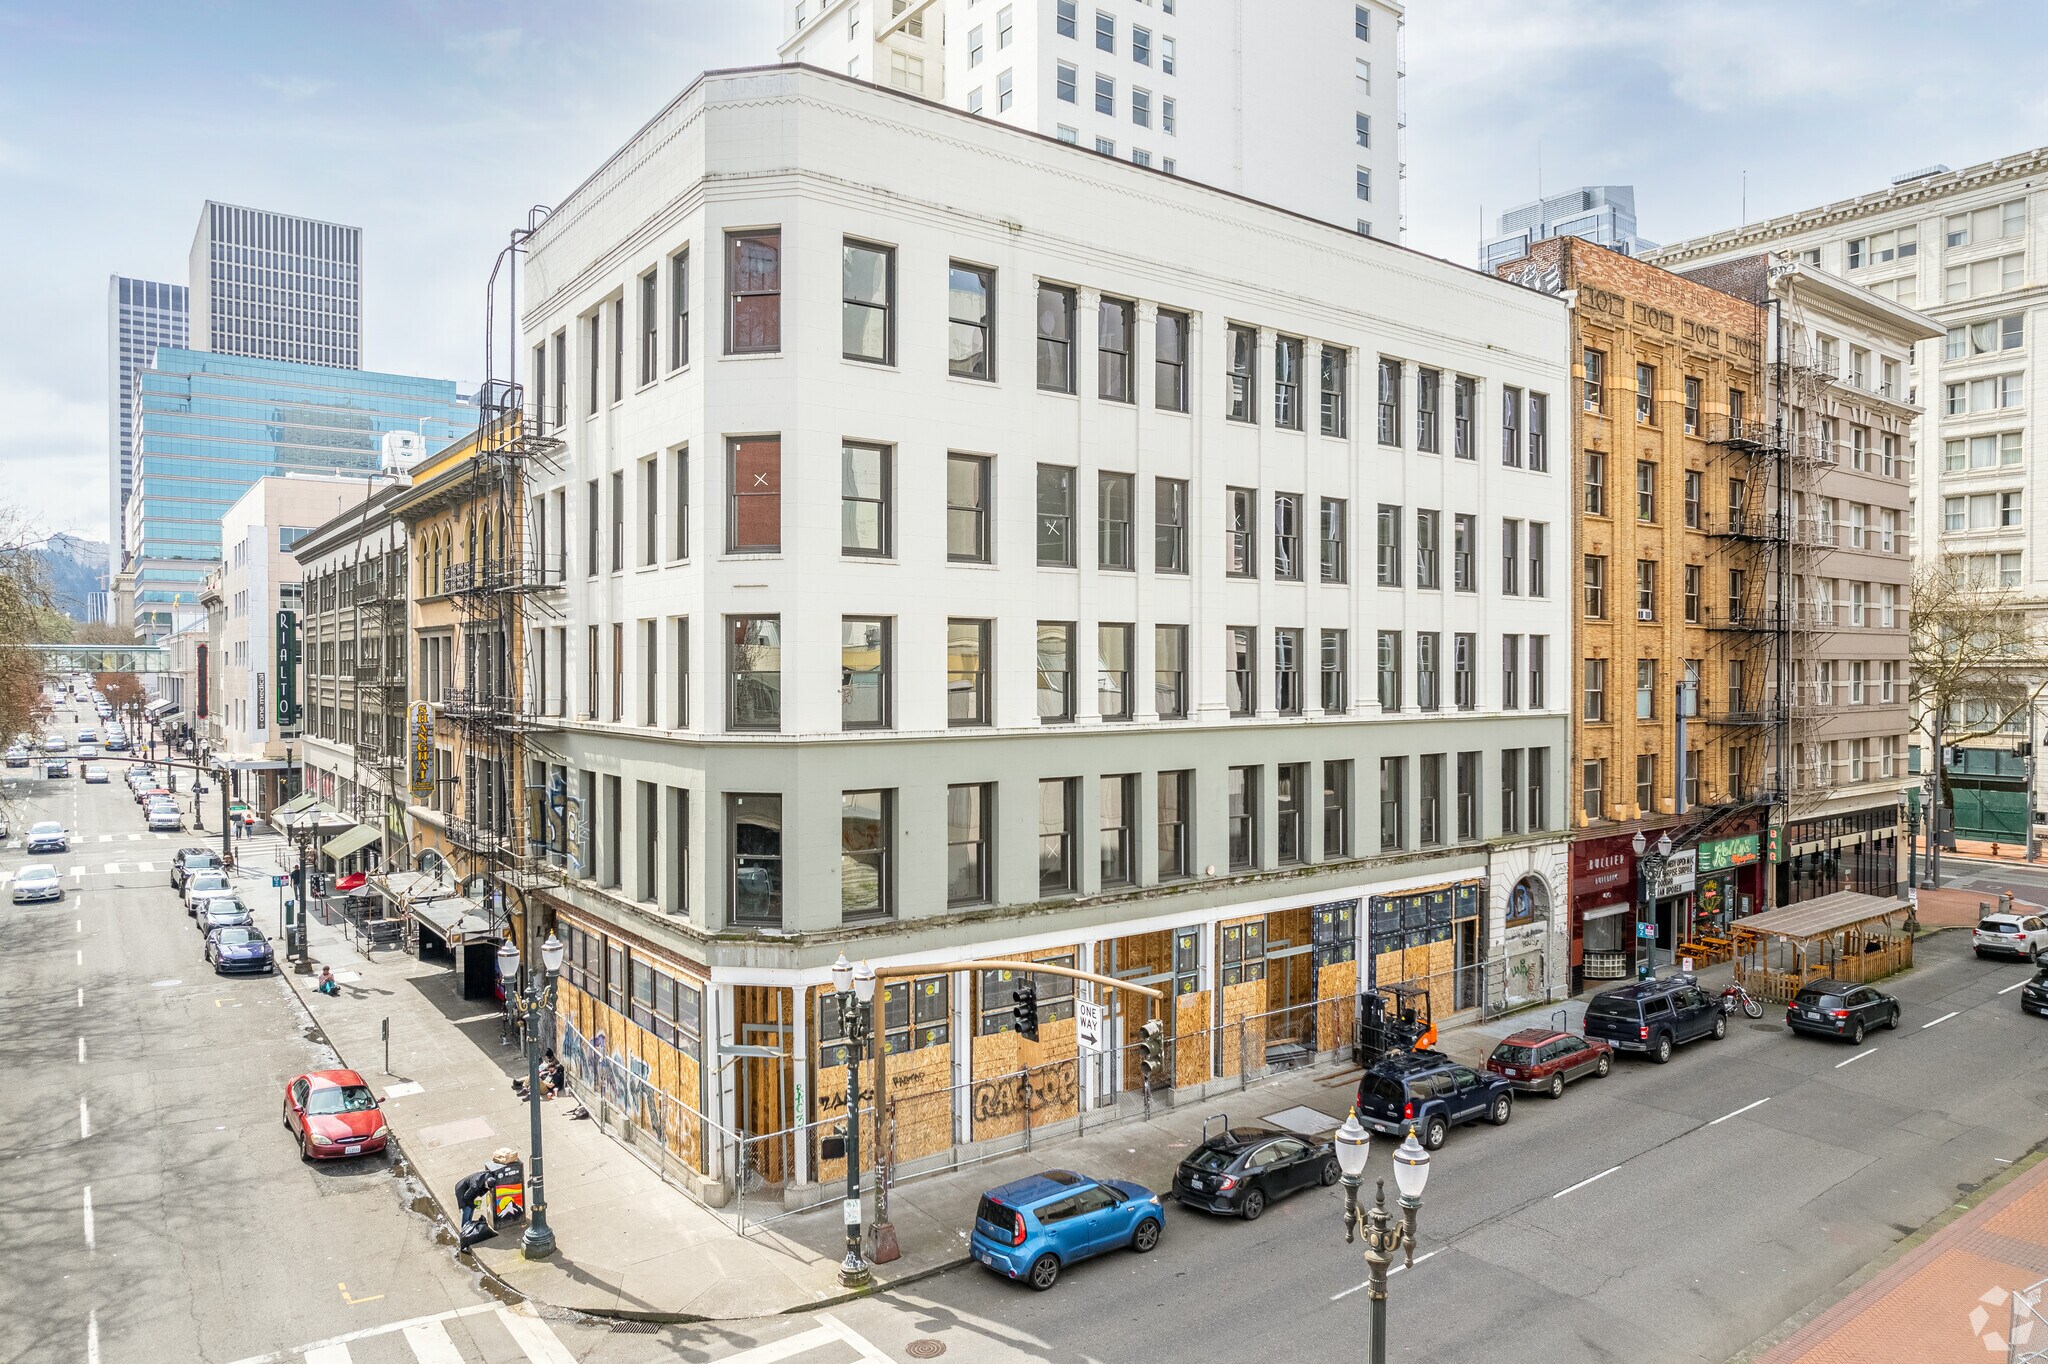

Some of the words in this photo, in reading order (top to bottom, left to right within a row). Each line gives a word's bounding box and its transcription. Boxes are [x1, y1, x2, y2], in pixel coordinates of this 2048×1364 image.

[279, 613, 289, 713] RIALTO
[417, 704, 428, 780] SHANGHAI
[1769, 829, 1777, 861] BAR
[1080, 1004, 1097, 1019] ONE
[1080, 1017, 1098, 1031] WAY
